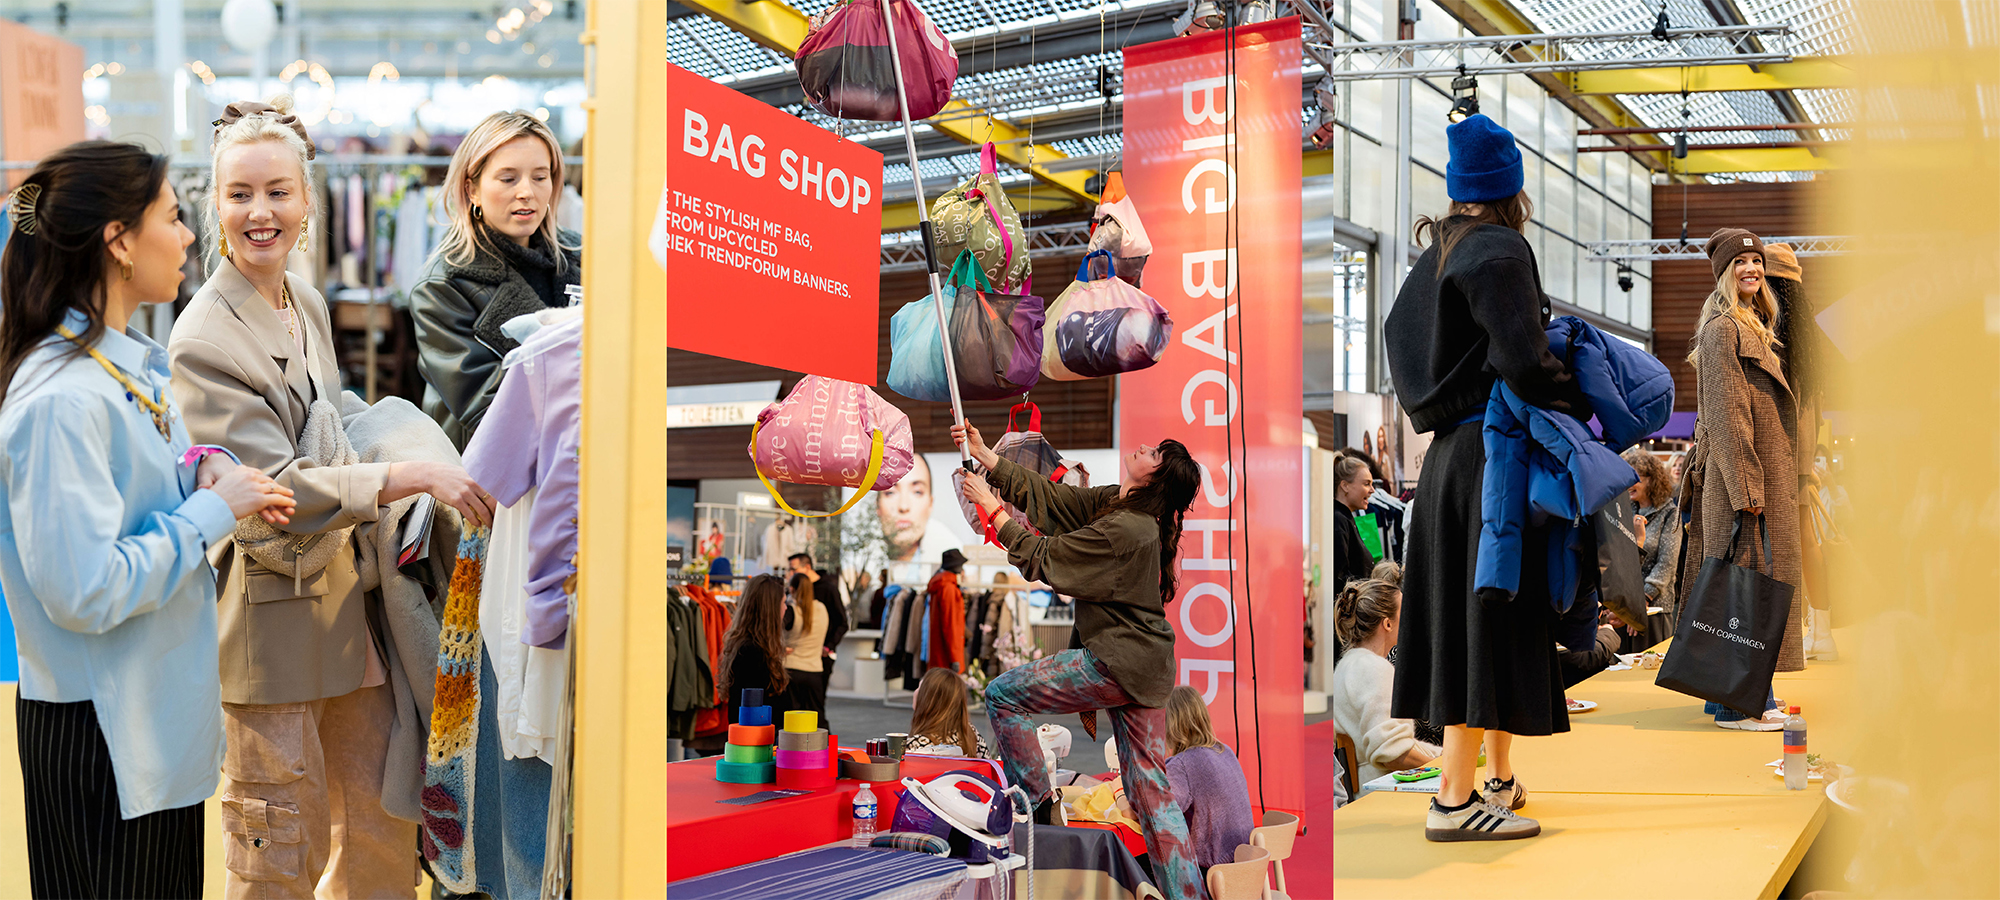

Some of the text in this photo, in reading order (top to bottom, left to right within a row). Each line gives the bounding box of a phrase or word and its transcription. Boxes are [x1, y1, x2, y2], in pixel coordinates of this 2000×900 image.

[683, 108, 871, 215] BAG SHOP
[666, 210, 778, 258] FROM UPCYCLED
[673, 190, 702, 215] THE
[705, 201, 760, 233] STYLISH
[763, 220, 782, 238] MF
[784, 227, 813, 252] BAG,
[698, 241, 790, 281] TRENDFORUM
[793, 269, 851, 299] BANNERS.
[1691, 619, 1766, 651] MSCH COPENHAGEN
